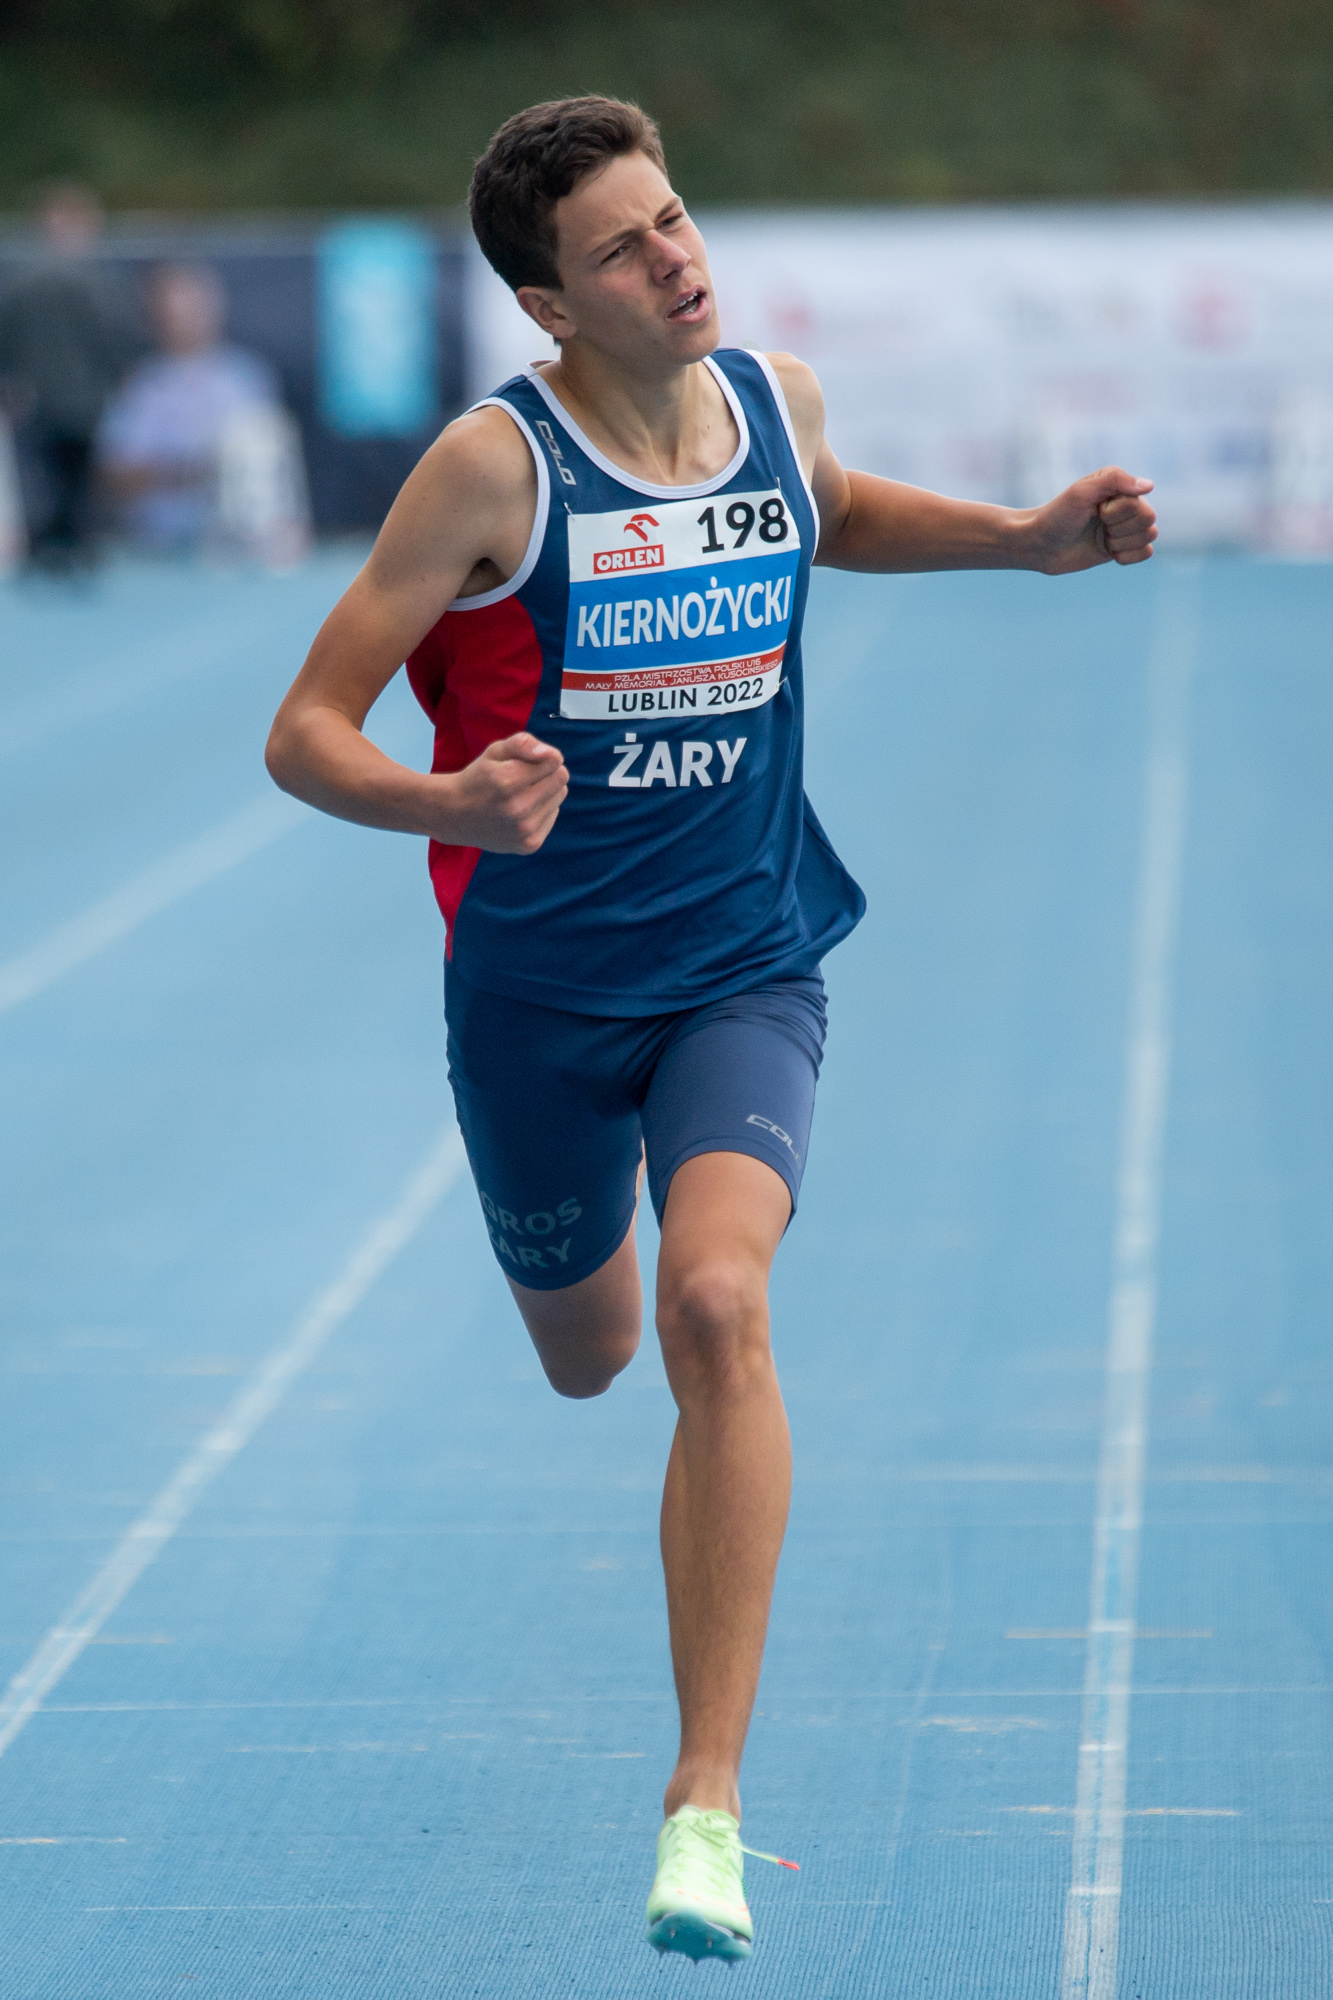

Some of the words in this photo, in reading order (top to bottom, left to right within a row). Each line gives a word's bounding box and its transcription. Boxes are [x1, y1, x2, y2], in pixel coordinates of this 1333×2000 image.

[697, 498, 789, 554] 198
[596, 547, 662, 571] ORLEN
[577, 576, 792, 648] KIERNOŻYCKI
[585, 682, 613, 690] MAŁY
[614, 680, 669, 689] MEMORIAŁ
[670, 674, 716, 685] JANUSZA
[614, 674, 640, 682] PZLA
[642, 667, 712, 680] MISTRZOSTWA
[714, 661, 745, 673] POLSKI
[608, 688, 698, 713] LUBLIN
[707, 677, 764, 706] 2022
[608, 732, 748, 788] ŻARY
